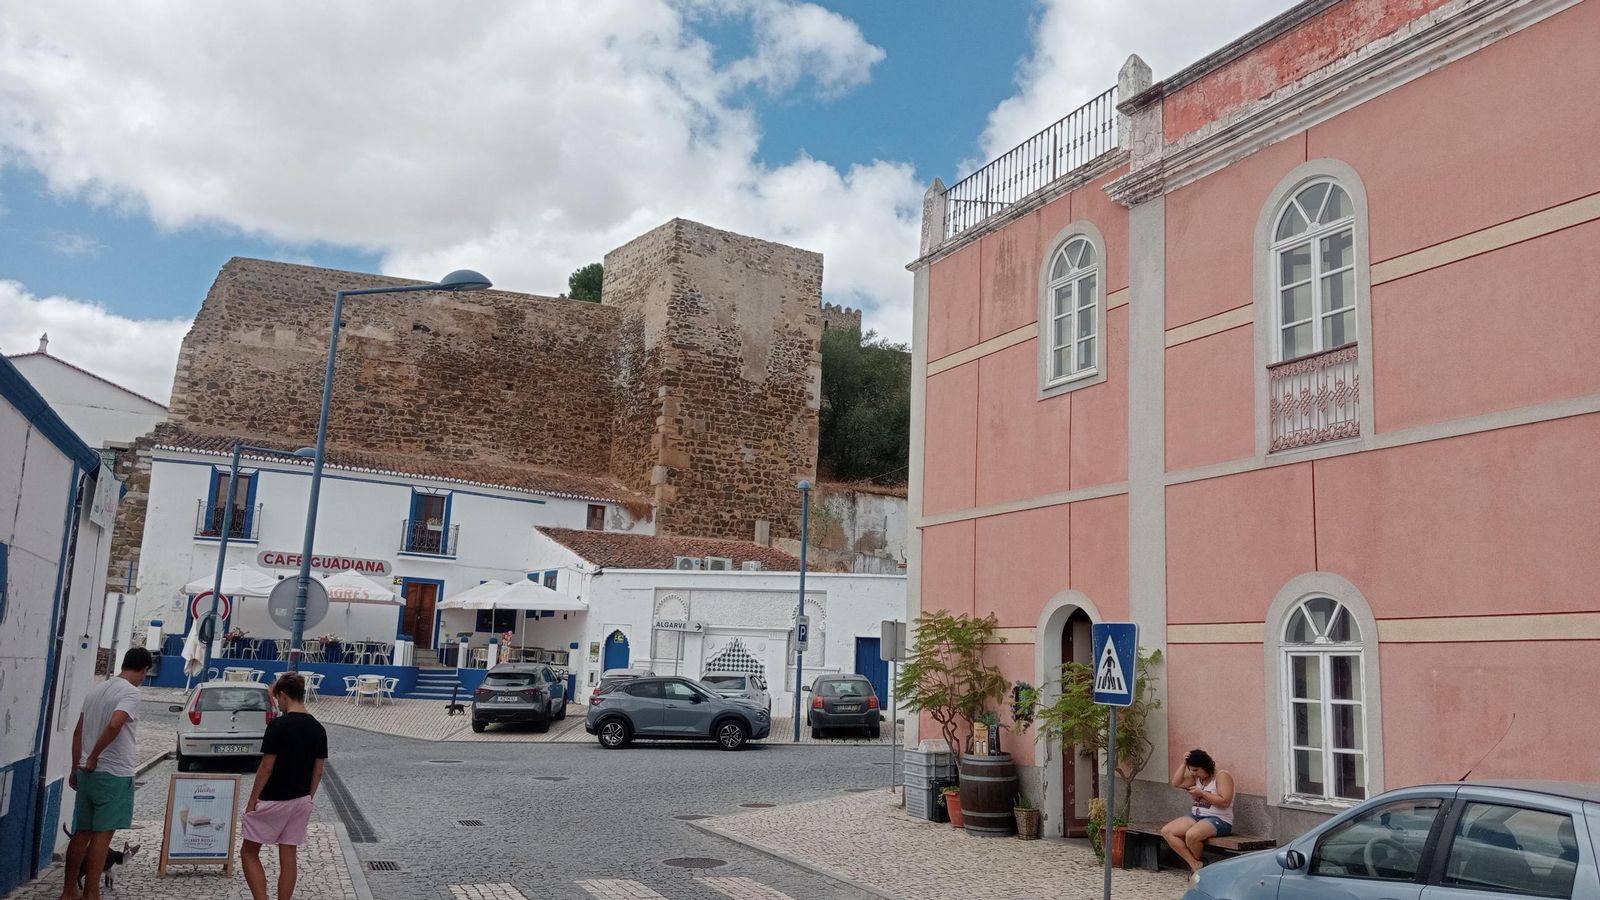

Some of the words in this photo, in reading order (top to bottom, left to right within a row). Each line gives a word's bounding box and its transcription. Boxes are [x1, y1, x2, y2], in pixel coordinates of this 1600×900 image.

[311, 556, 385, 573] GUADIANA
[655, 621, 687, 629] ALGARVE
[800, 625, 806, 641] P
